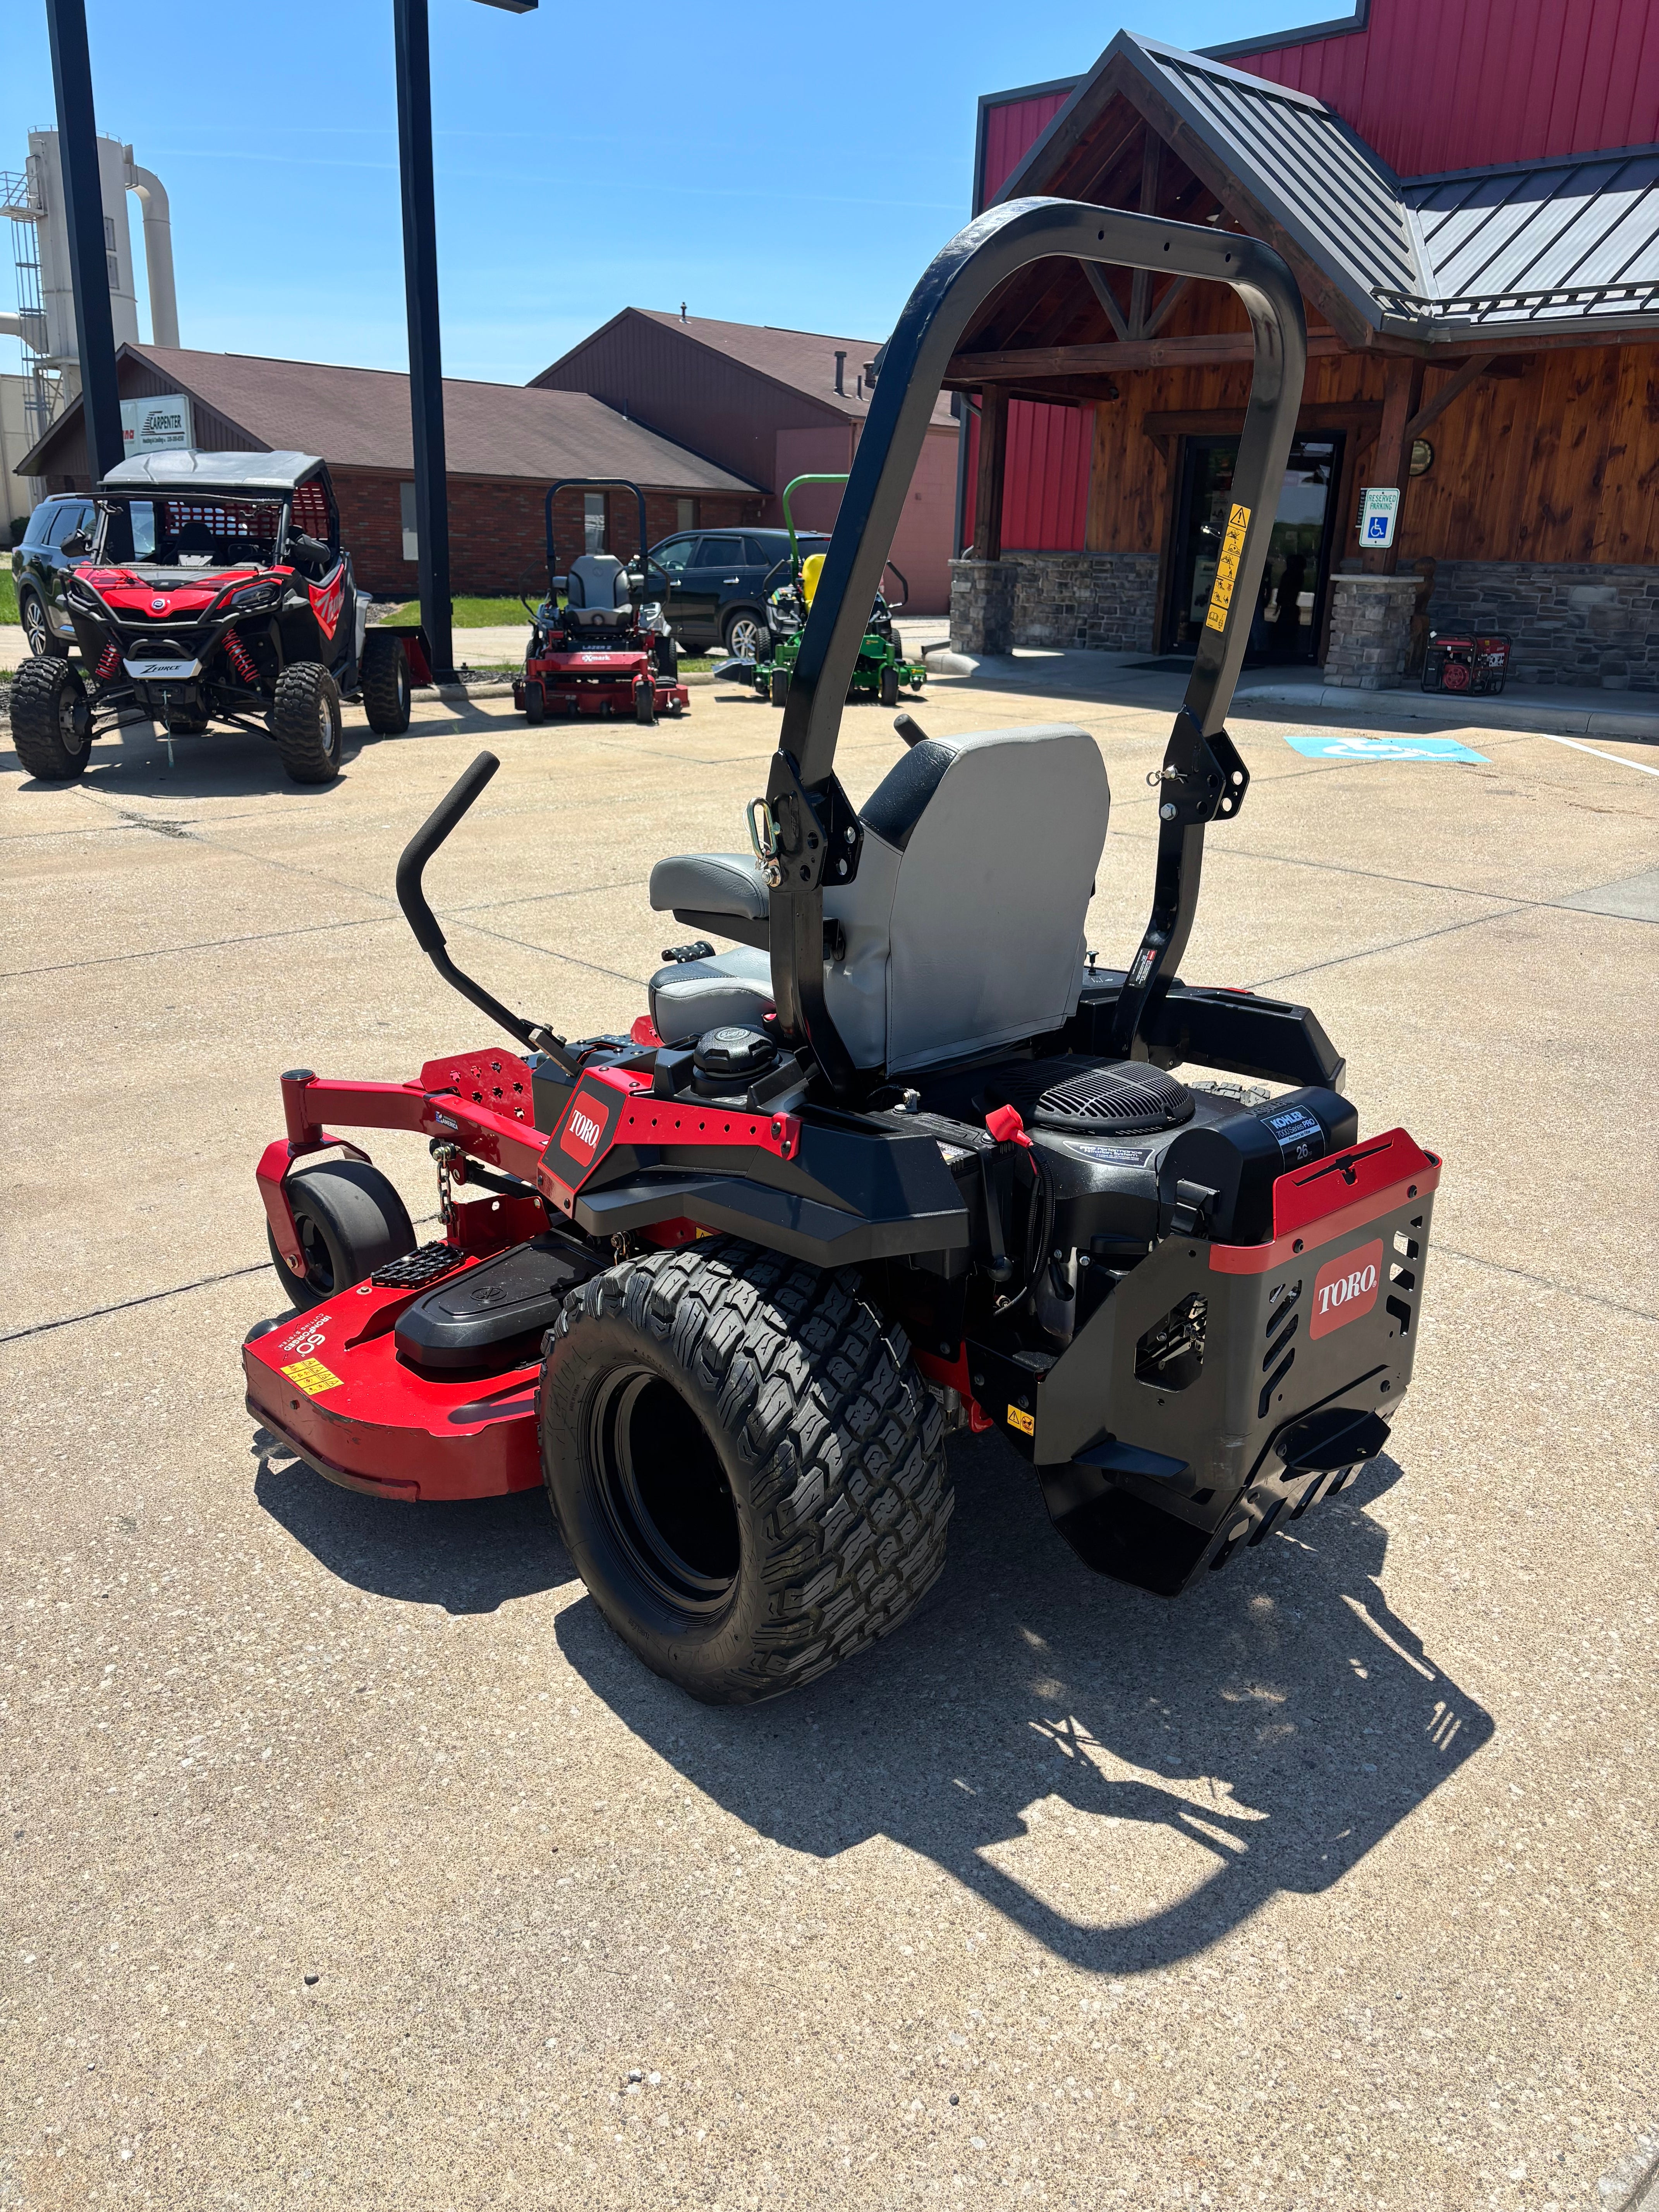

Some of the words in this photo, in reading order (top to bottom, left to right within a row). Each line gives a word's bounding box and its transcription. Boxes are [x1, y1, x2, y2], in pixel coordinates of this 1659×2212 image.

[150, 415, 182, 430] CARPENTER
[569, 1109, 599, 1147] TORO
[1270, 1111, 1305, 1129] KOHLER
[1276, 1128, 1290, 1138] 7000
[1288, 1124, 1304, 1133] Series
[1302, 1118, 1315, 1128] PRO
[1297, 1144, 1308, 1160] 26
[1319, 1264, 1376, 1315] TORO
[301, 1313, 324, 1330] CUTTING
[278, 1331, 301, 1348] SYSTEM
[284, 1315, 332, 1351] IRONFORGED
